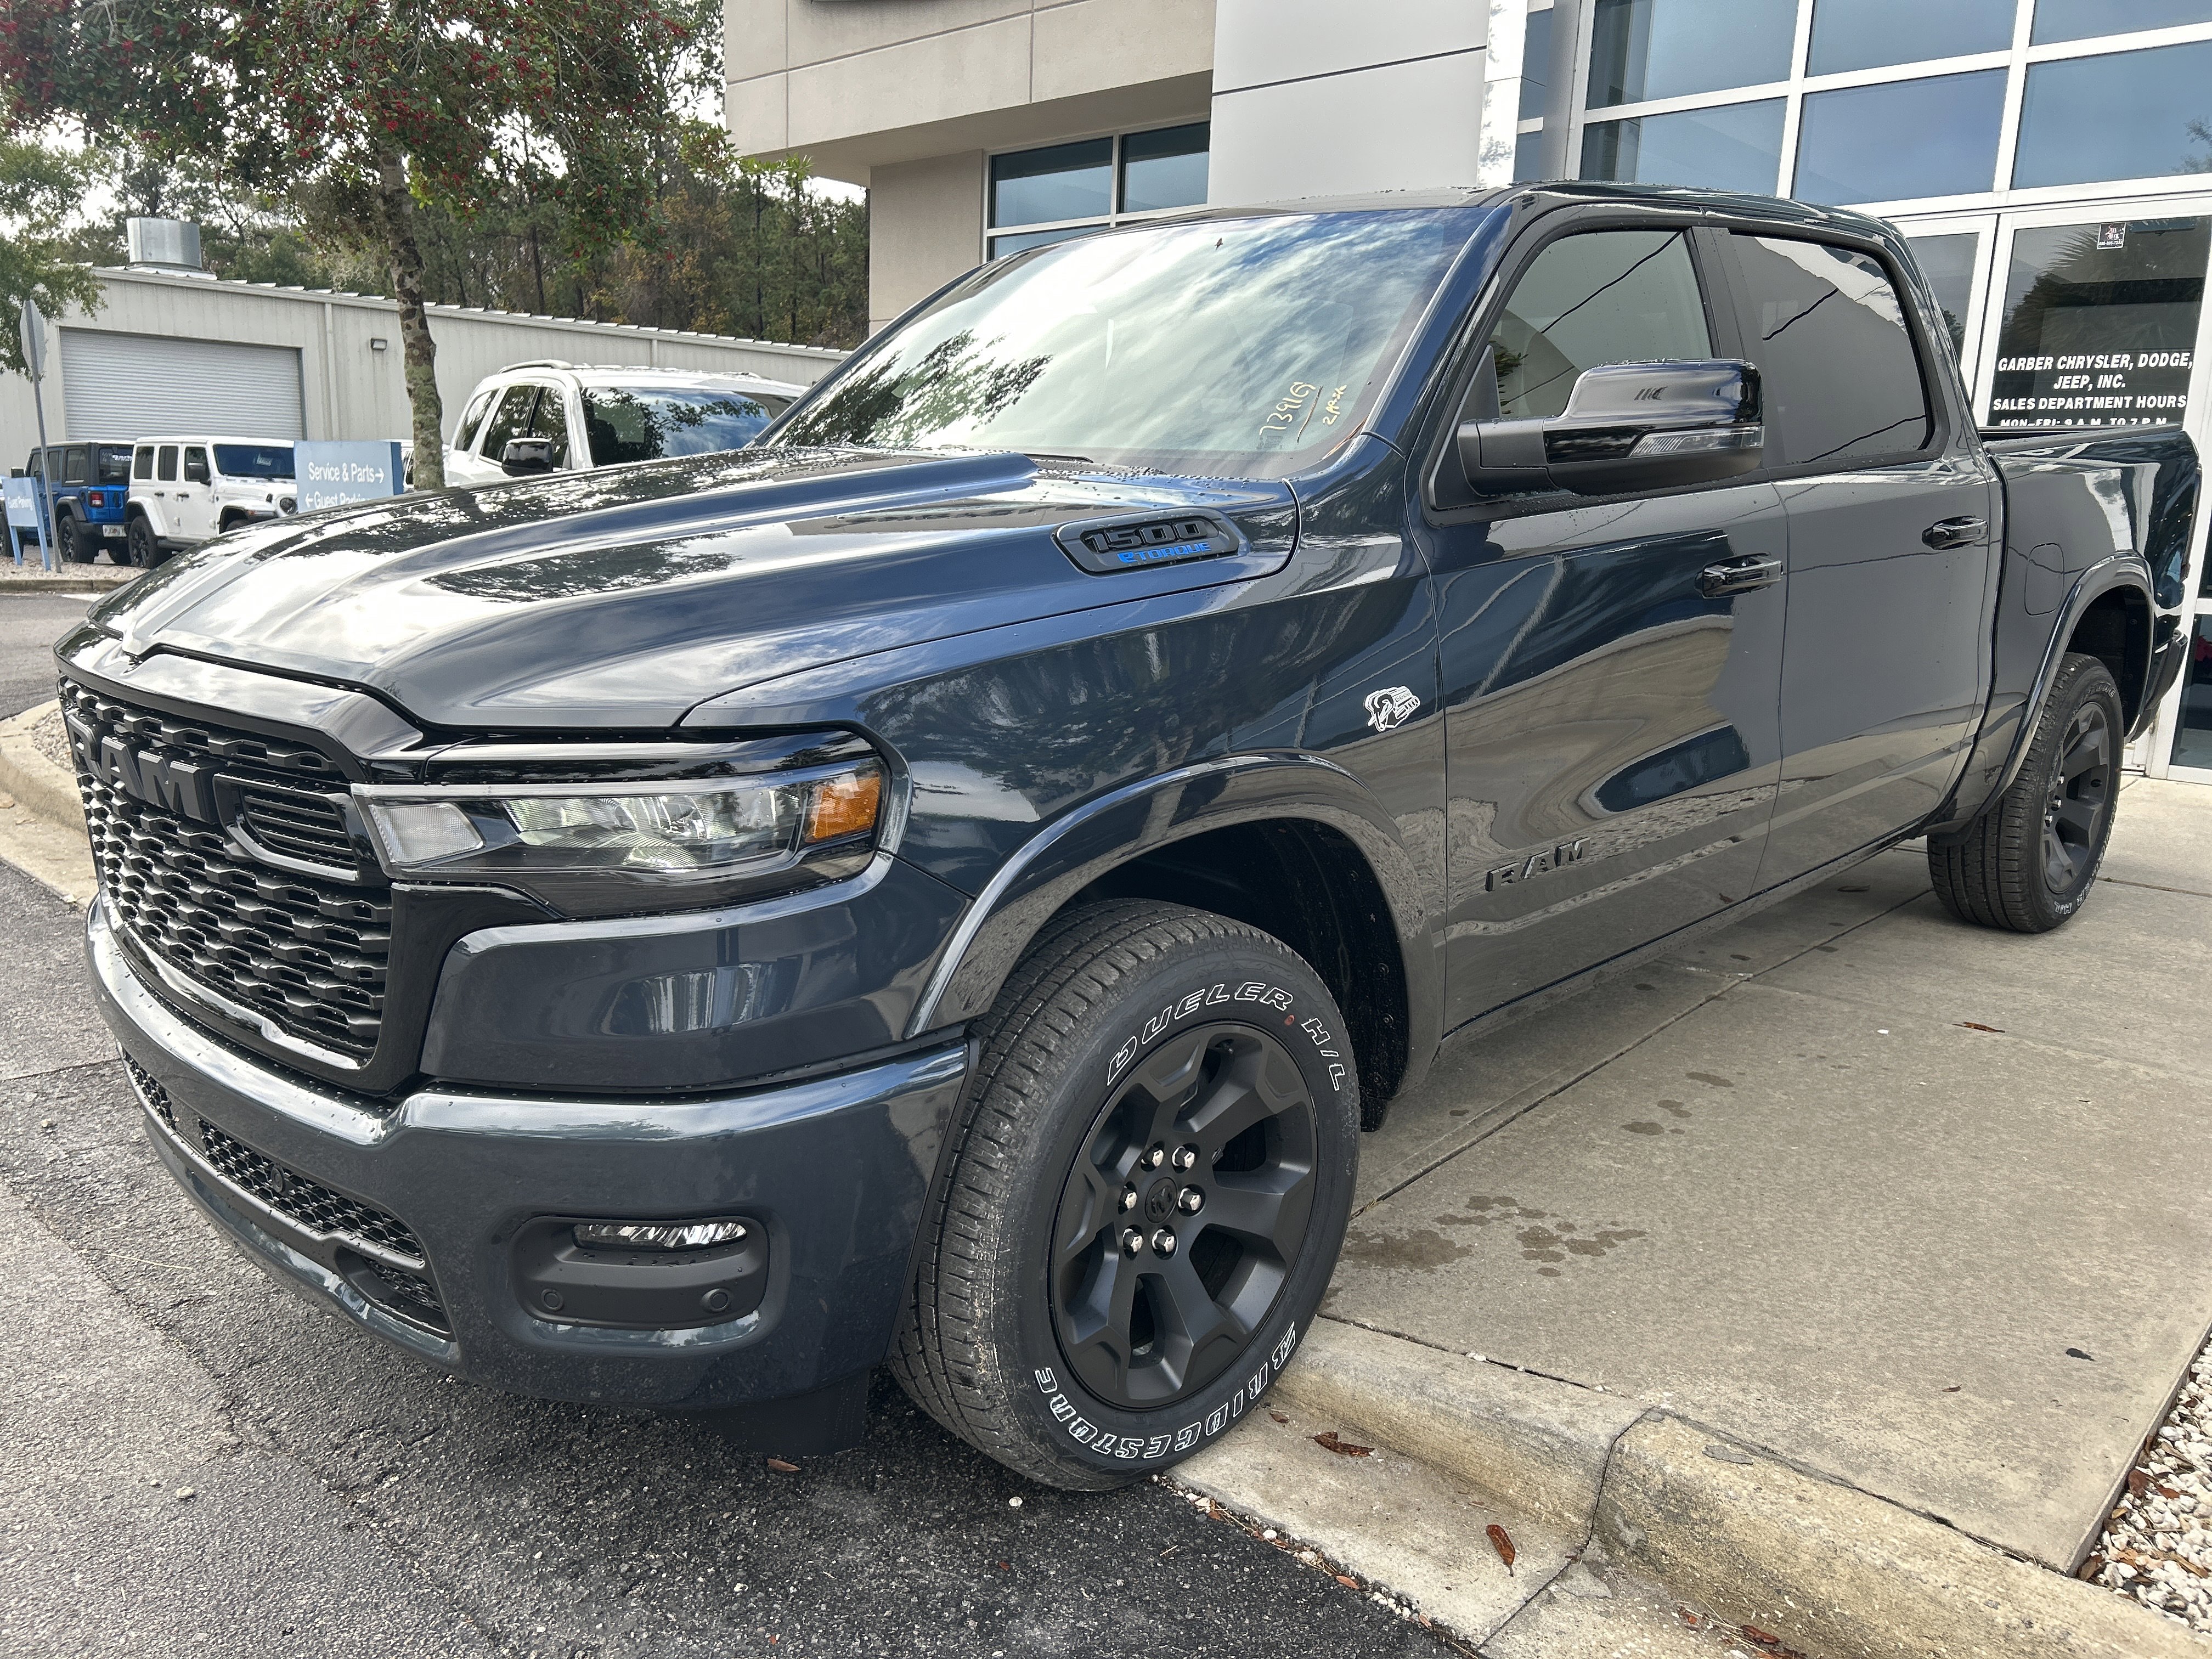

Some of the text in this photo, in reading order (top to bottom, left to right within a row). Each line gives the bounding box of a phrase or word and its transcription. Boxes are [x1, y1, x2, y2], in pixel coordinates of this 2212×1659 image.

[1998, 352, 2193, 371] GARBER CHRYSLER, DODGE,
[2053, 374, 2126, 392] JEEP, INC.
[1993, 395, 2187, 410] SALES DEPARTMENT HOURS
[2109, 417, 2126, 426] TO
[308, 461, 375, 483] Service & Parts
[314, 491, 338, 510] Guest
[1085, 521, 1209, 554] 1500
[67, 713, 216, 823] RAM
[1485, 837, 1590, 892] RAM
[1106, 981, 1294, 1087] DUELER
[1034, 1321, 1296, 1459] BRIDGESTONE
